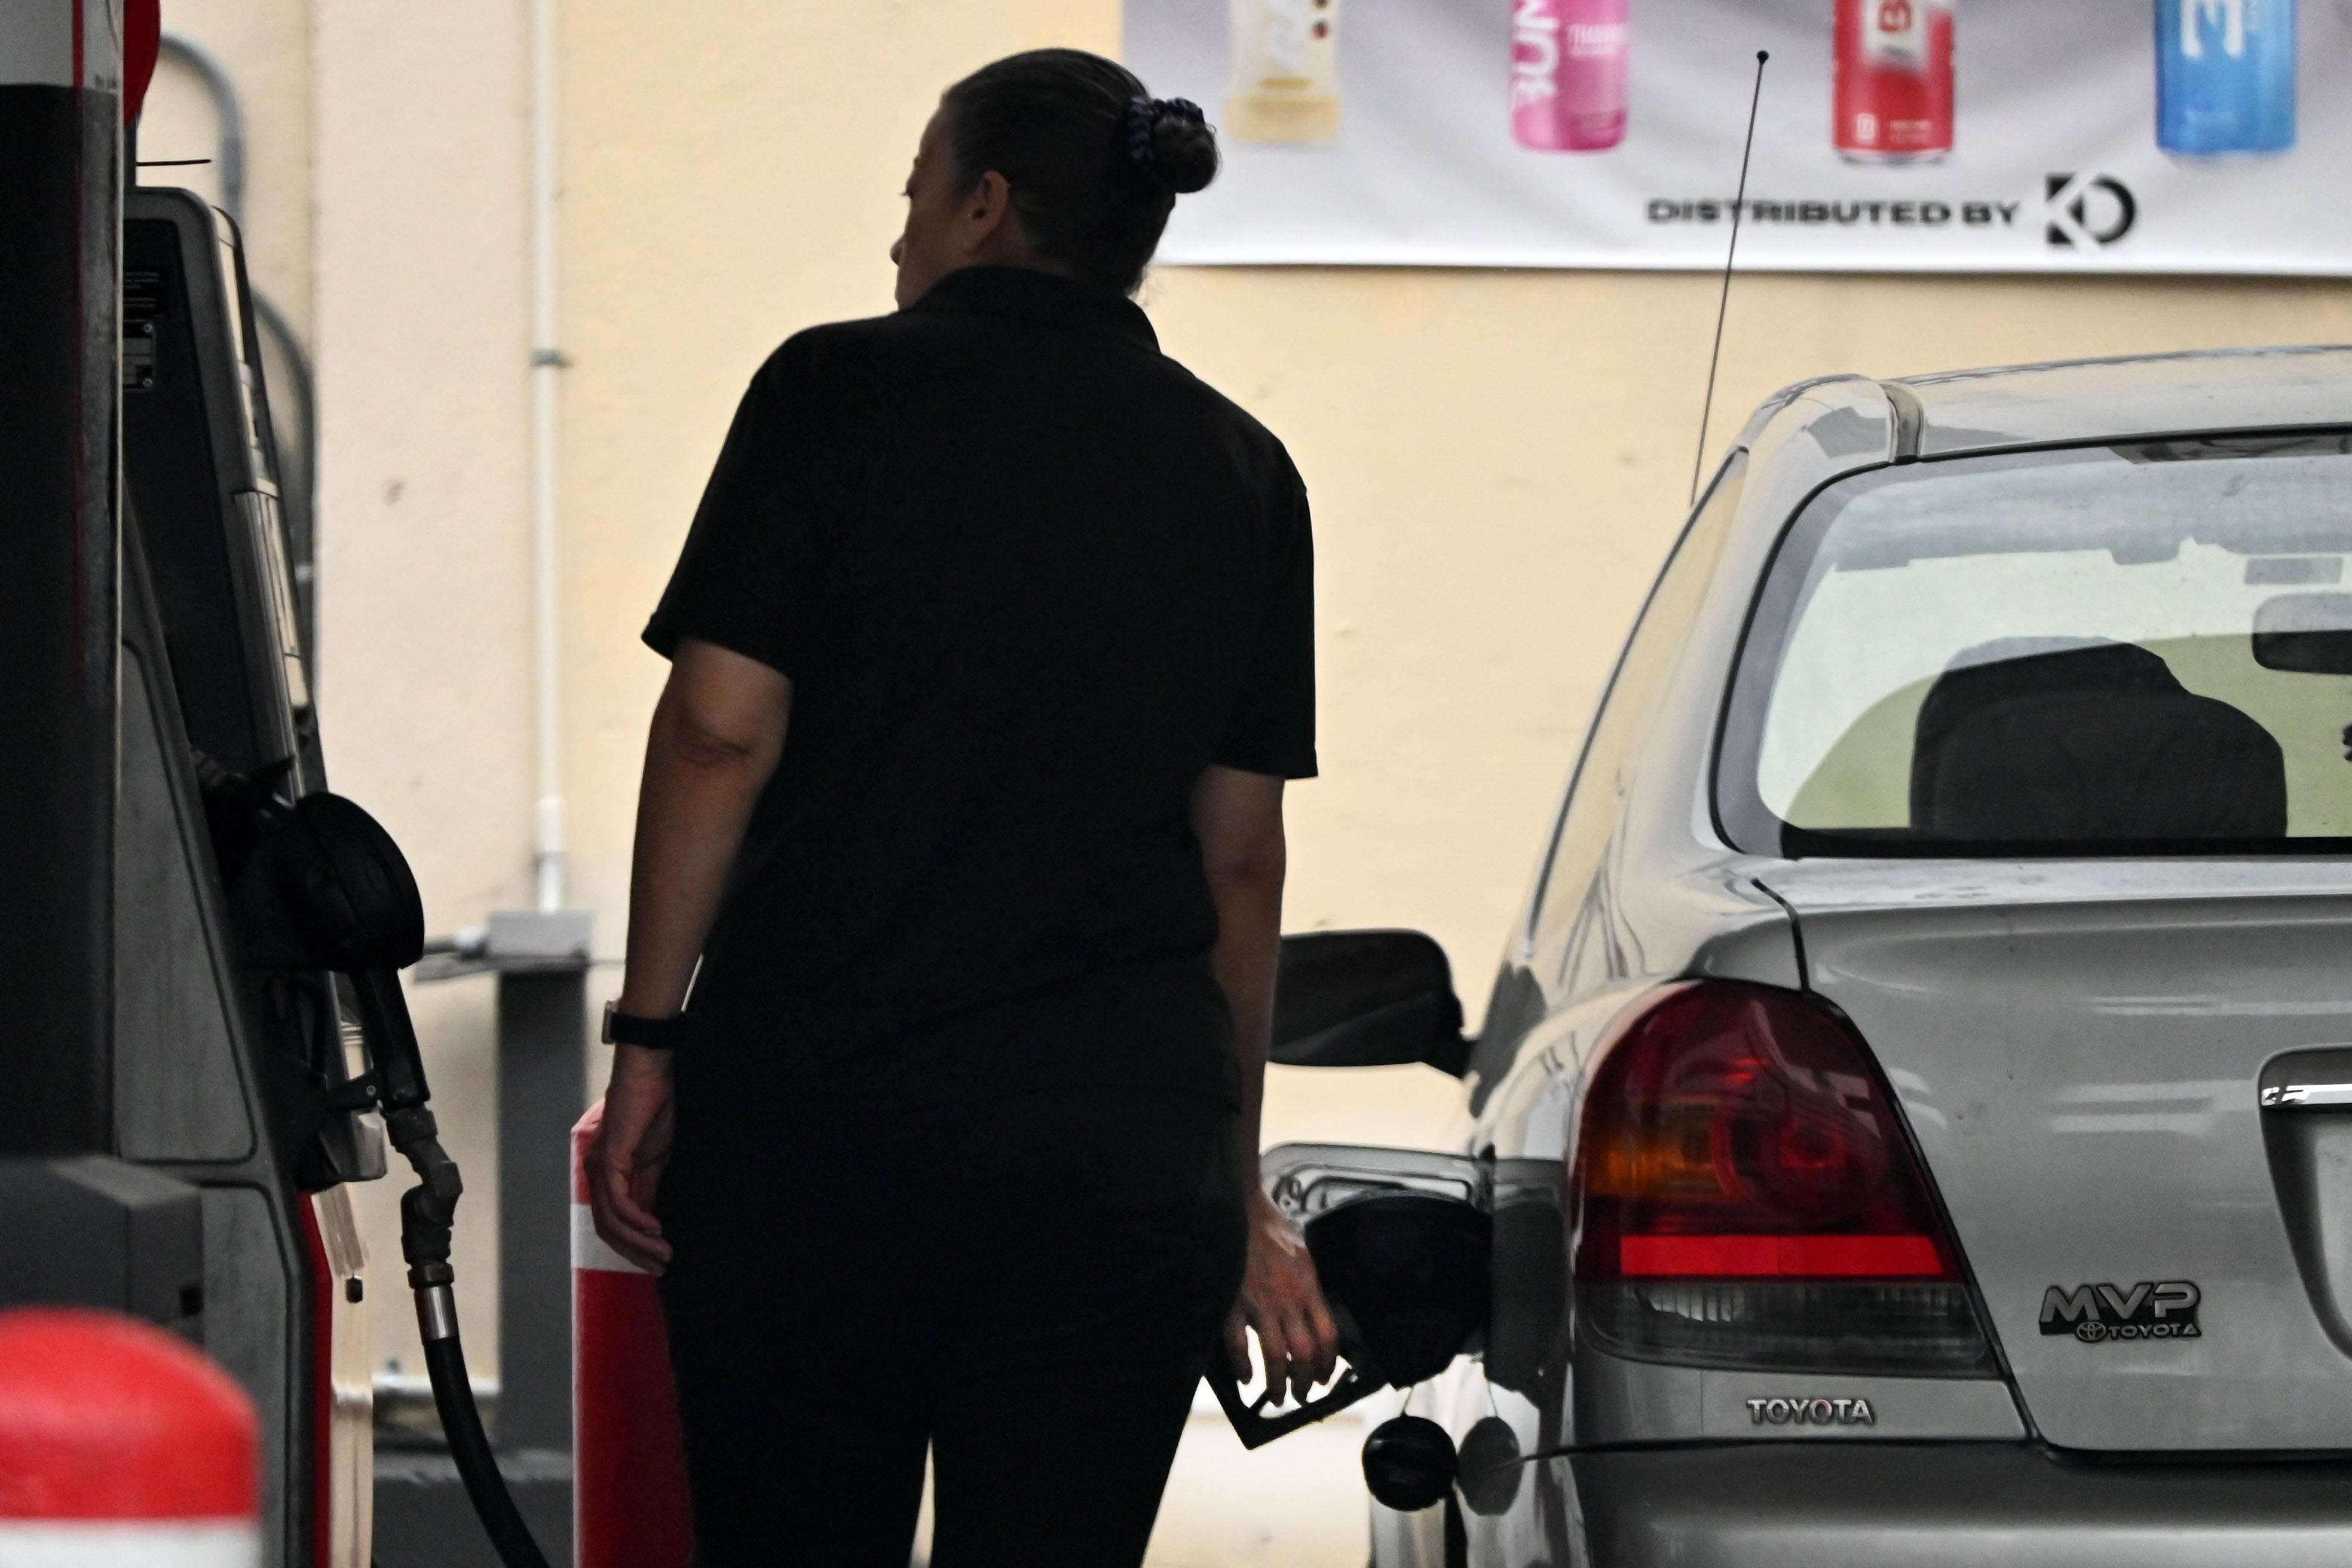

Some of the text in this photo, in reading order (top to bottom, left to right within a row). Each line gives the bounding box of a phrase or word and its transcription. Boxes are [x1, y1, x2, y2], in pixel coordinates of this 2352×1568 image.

[1647, 199, 1952, 225] DISTRIBUTED
[1961, 201, 2021, 225] BY
[2039, 1281, 2201, 1323] MVP
[2108, 1322, 2201, 1339] TOYOTA
[1747, 1398, 1875, 1425] TOYOTA
